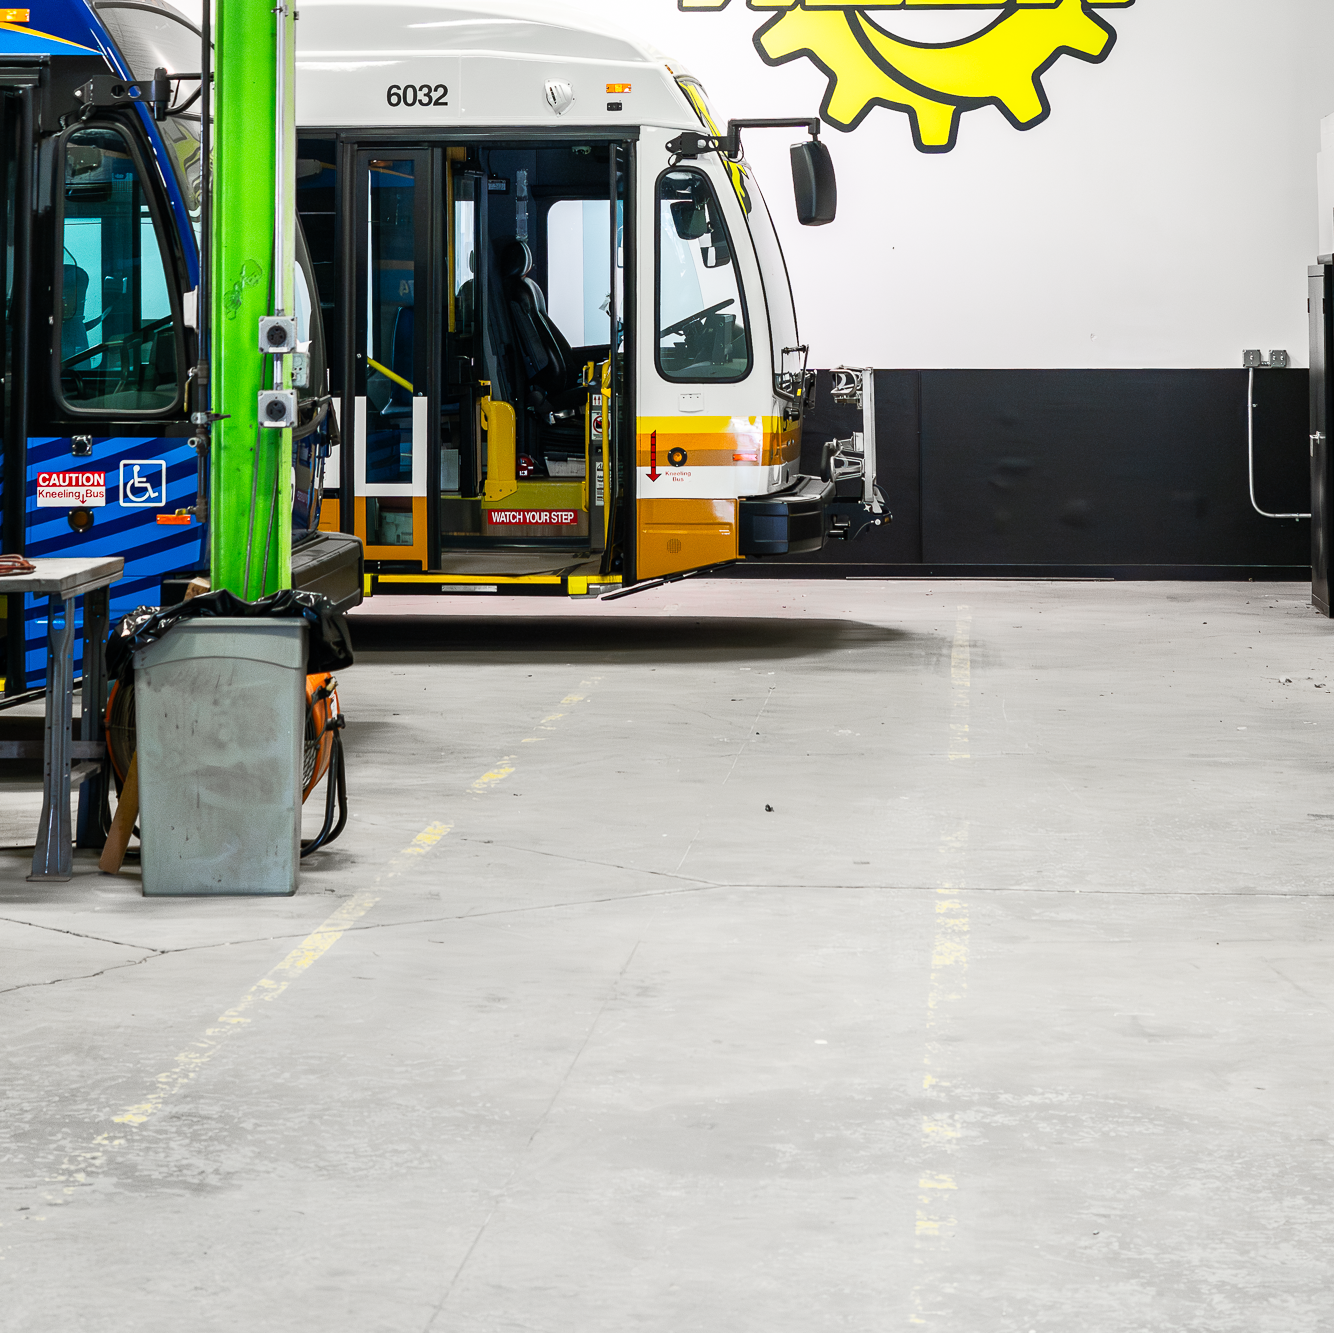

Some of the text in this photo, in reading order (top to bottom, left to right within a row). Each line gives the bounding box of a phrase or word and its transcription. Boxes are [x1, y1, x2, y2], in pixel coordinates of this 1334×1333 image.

[386, 83, 449, 107] 6032
[38, 473, 104, 486] CAUTION
[38, 488, 104, 500] Kneeling Bus
[491, 511, 574, 523] WATCH YOUR STEP
